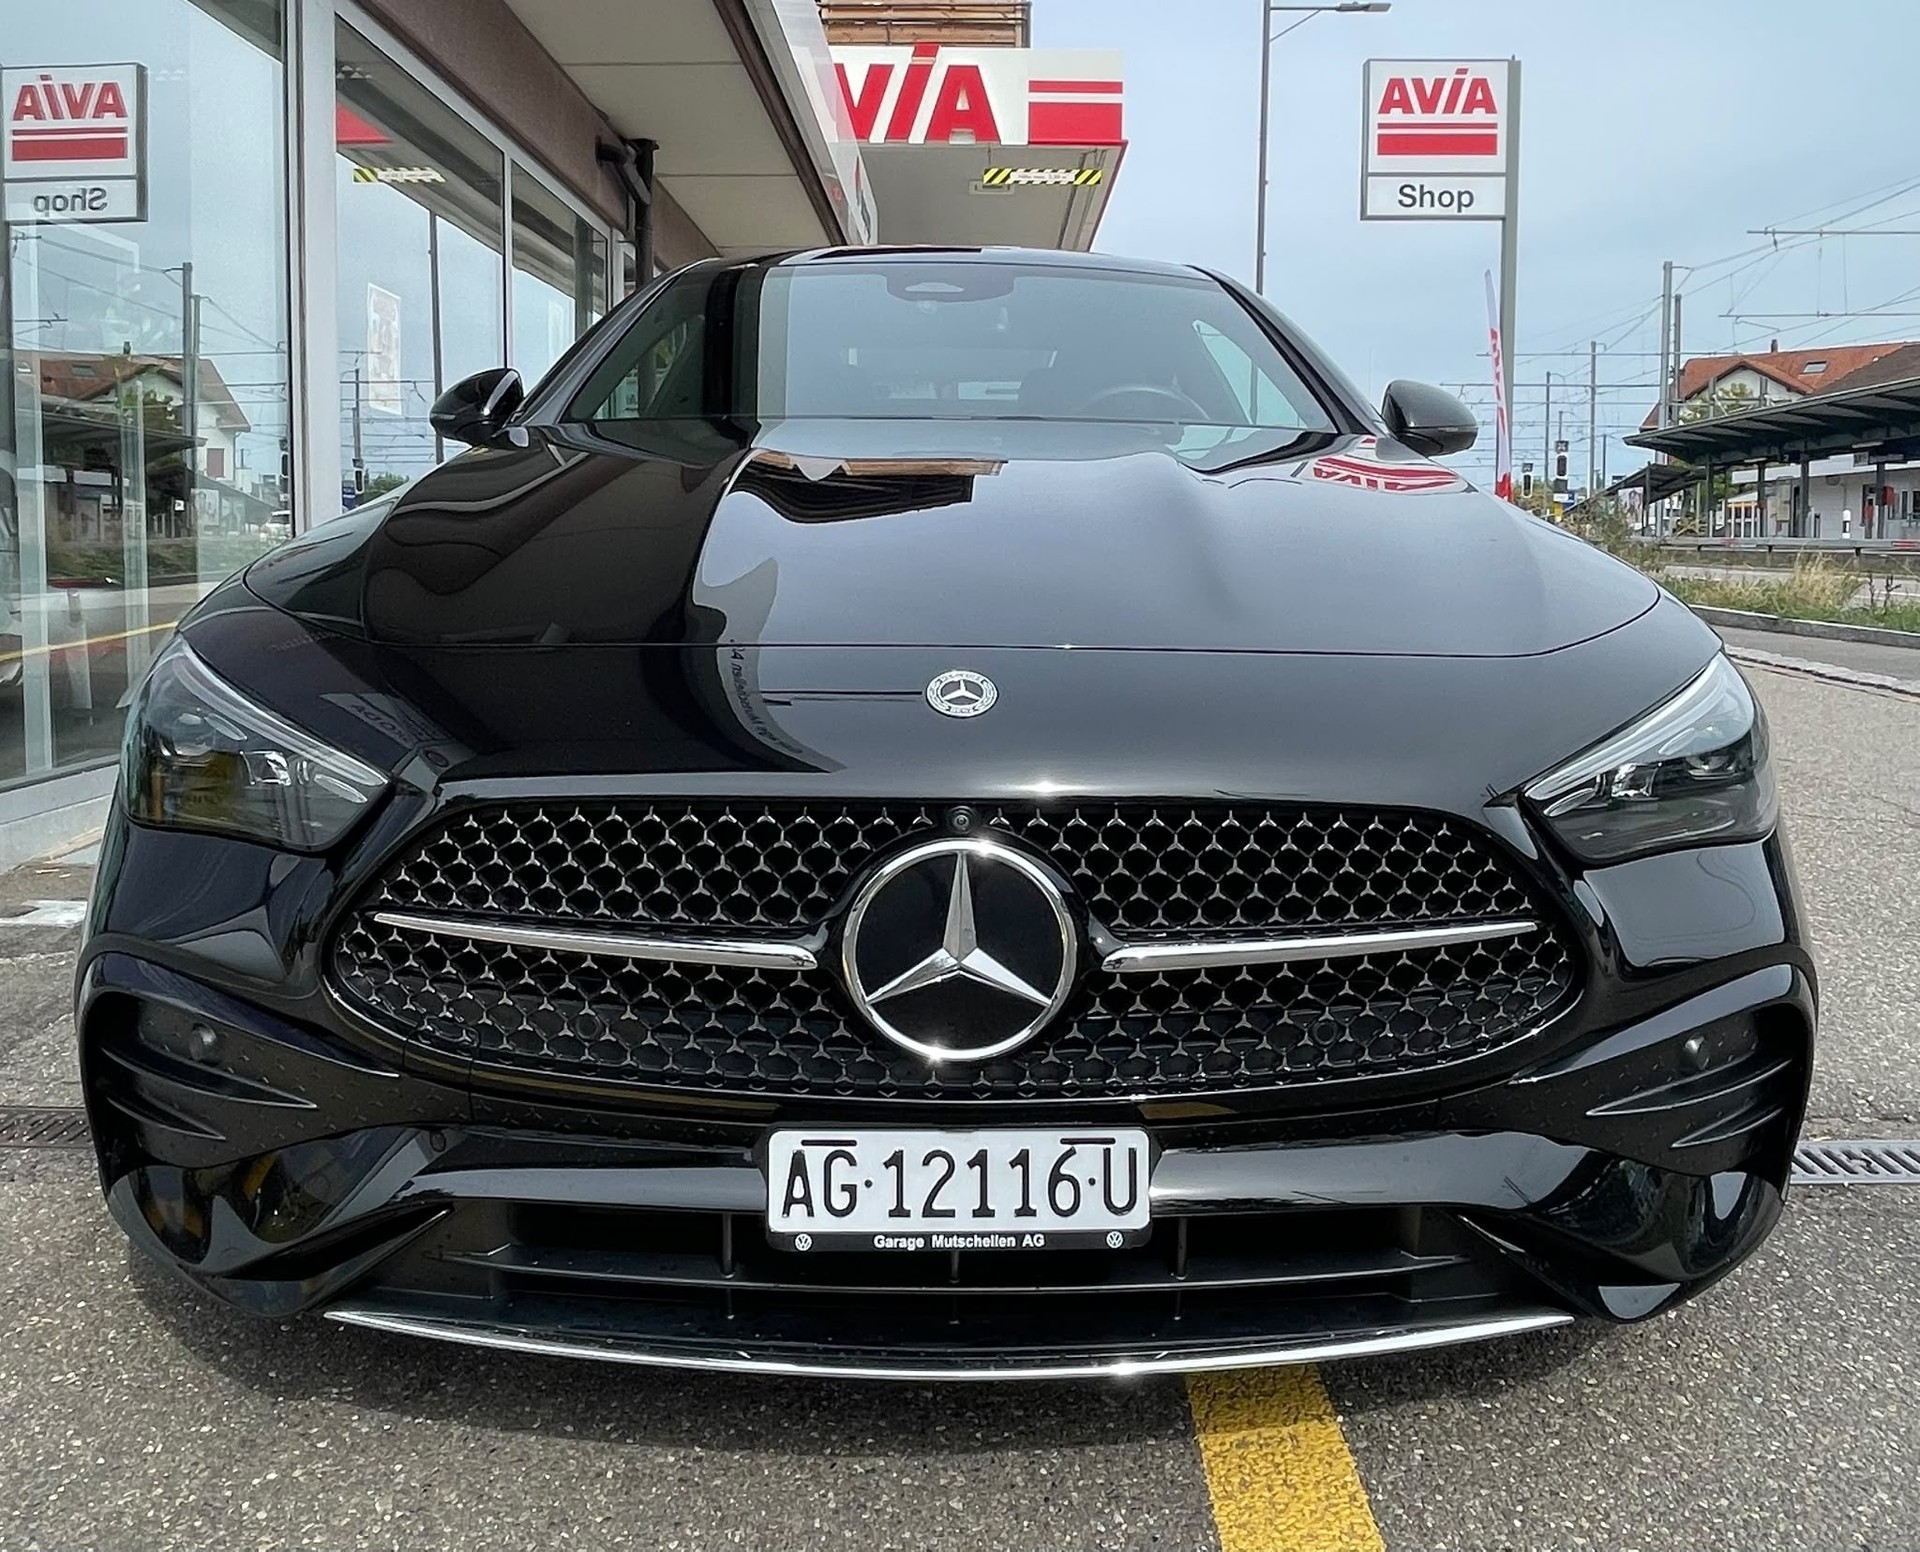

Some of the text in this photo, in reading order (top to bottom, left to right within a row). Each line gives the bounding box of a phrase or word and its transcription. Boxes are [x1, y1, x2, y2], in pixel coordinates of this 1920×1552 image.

[833, 40, 1001, 142] VIA
[1378, 68, 1498, 114] AVIA
[1397, 183, 1475, 213] Shop
[873, 1234, 925, 1251] Garage
[1022, 1233, 1046, 1248] AG
